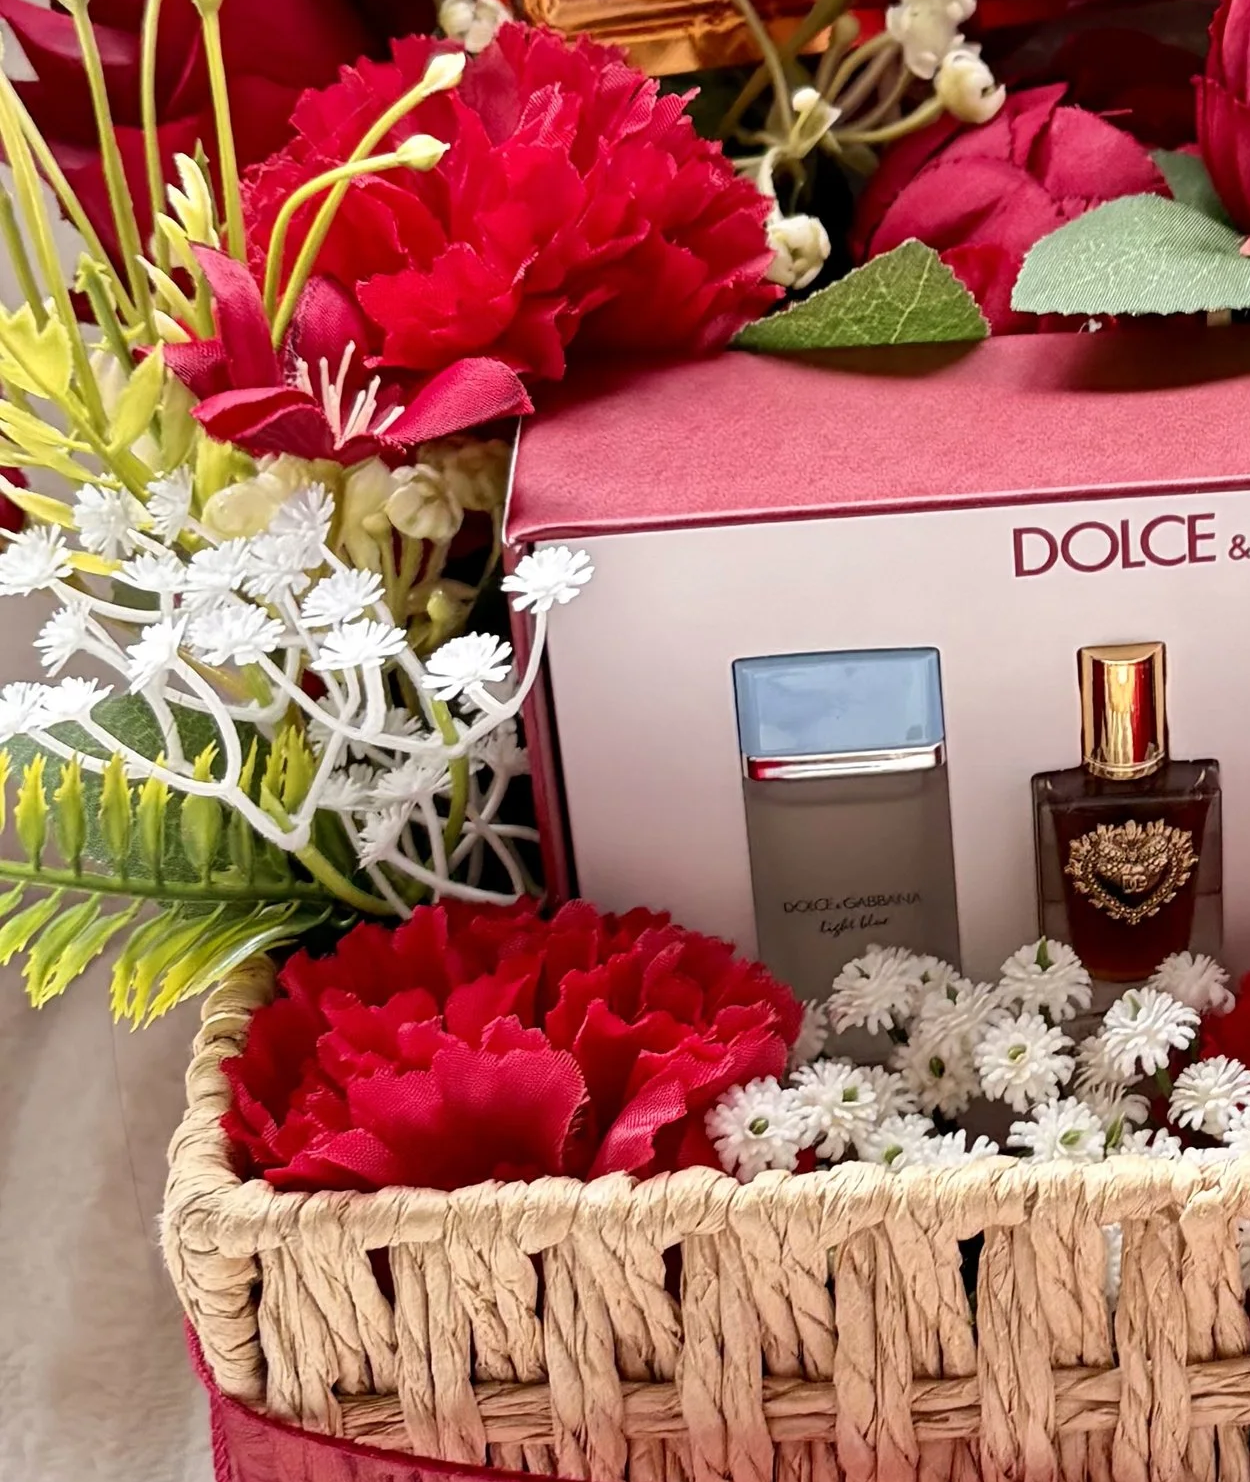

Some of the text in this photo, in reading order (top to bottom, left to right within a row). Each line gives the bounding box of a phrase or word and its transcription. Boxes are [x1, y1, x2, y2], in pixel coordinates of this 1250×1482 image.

[1013, 513, 1216, 577] DOLCE
[784, 897, 834, 913] DOLCE
[843, 891, 922, 909] GABBANA
